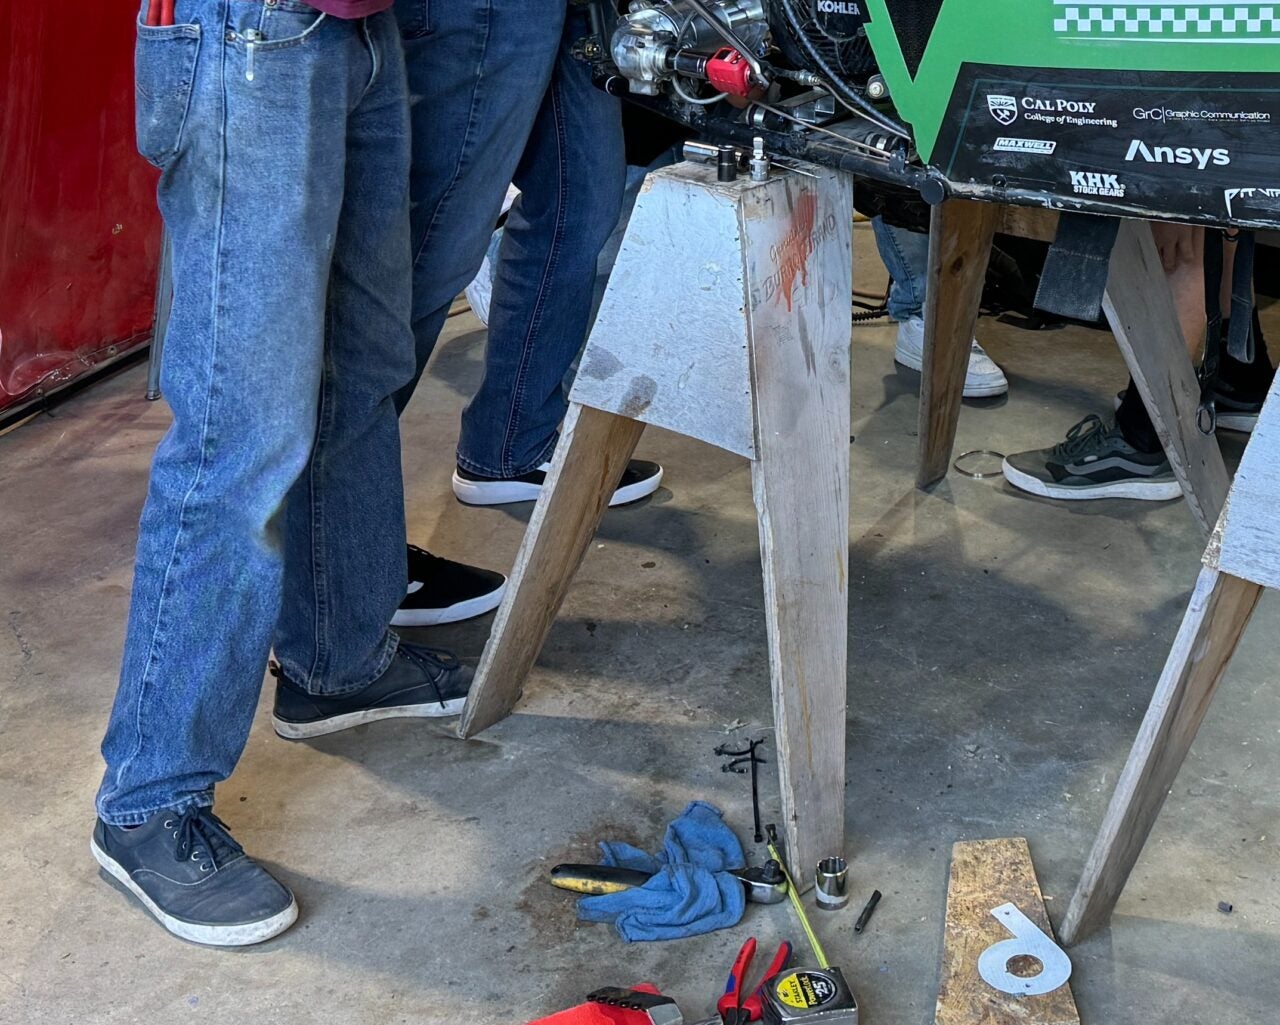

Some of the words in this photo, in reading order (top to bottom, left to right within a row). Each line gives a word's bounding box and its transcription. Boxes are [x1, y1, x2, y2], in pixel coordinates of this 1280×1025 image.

[1021, 97, 1054, 111] CAL
[1055, 99, 1096, 113] POLY
[1024, 112, 1055, 124] College
[1056, 115, 1066, 124] of
[1066, 116, 1118, 128] Engineering
[1165, 109, 1200, 120] Graphic
[1200, 110, 1271, 120] Communication
[998, 139, 1051, 150] MAXWELL
[1125, 139, 1230, 169] Ansys
[1069, 171, 1120, 189] KHK
[1073, 185, 1098, 195] STOCK
[1099, 187, 1124, 197] GEARS
